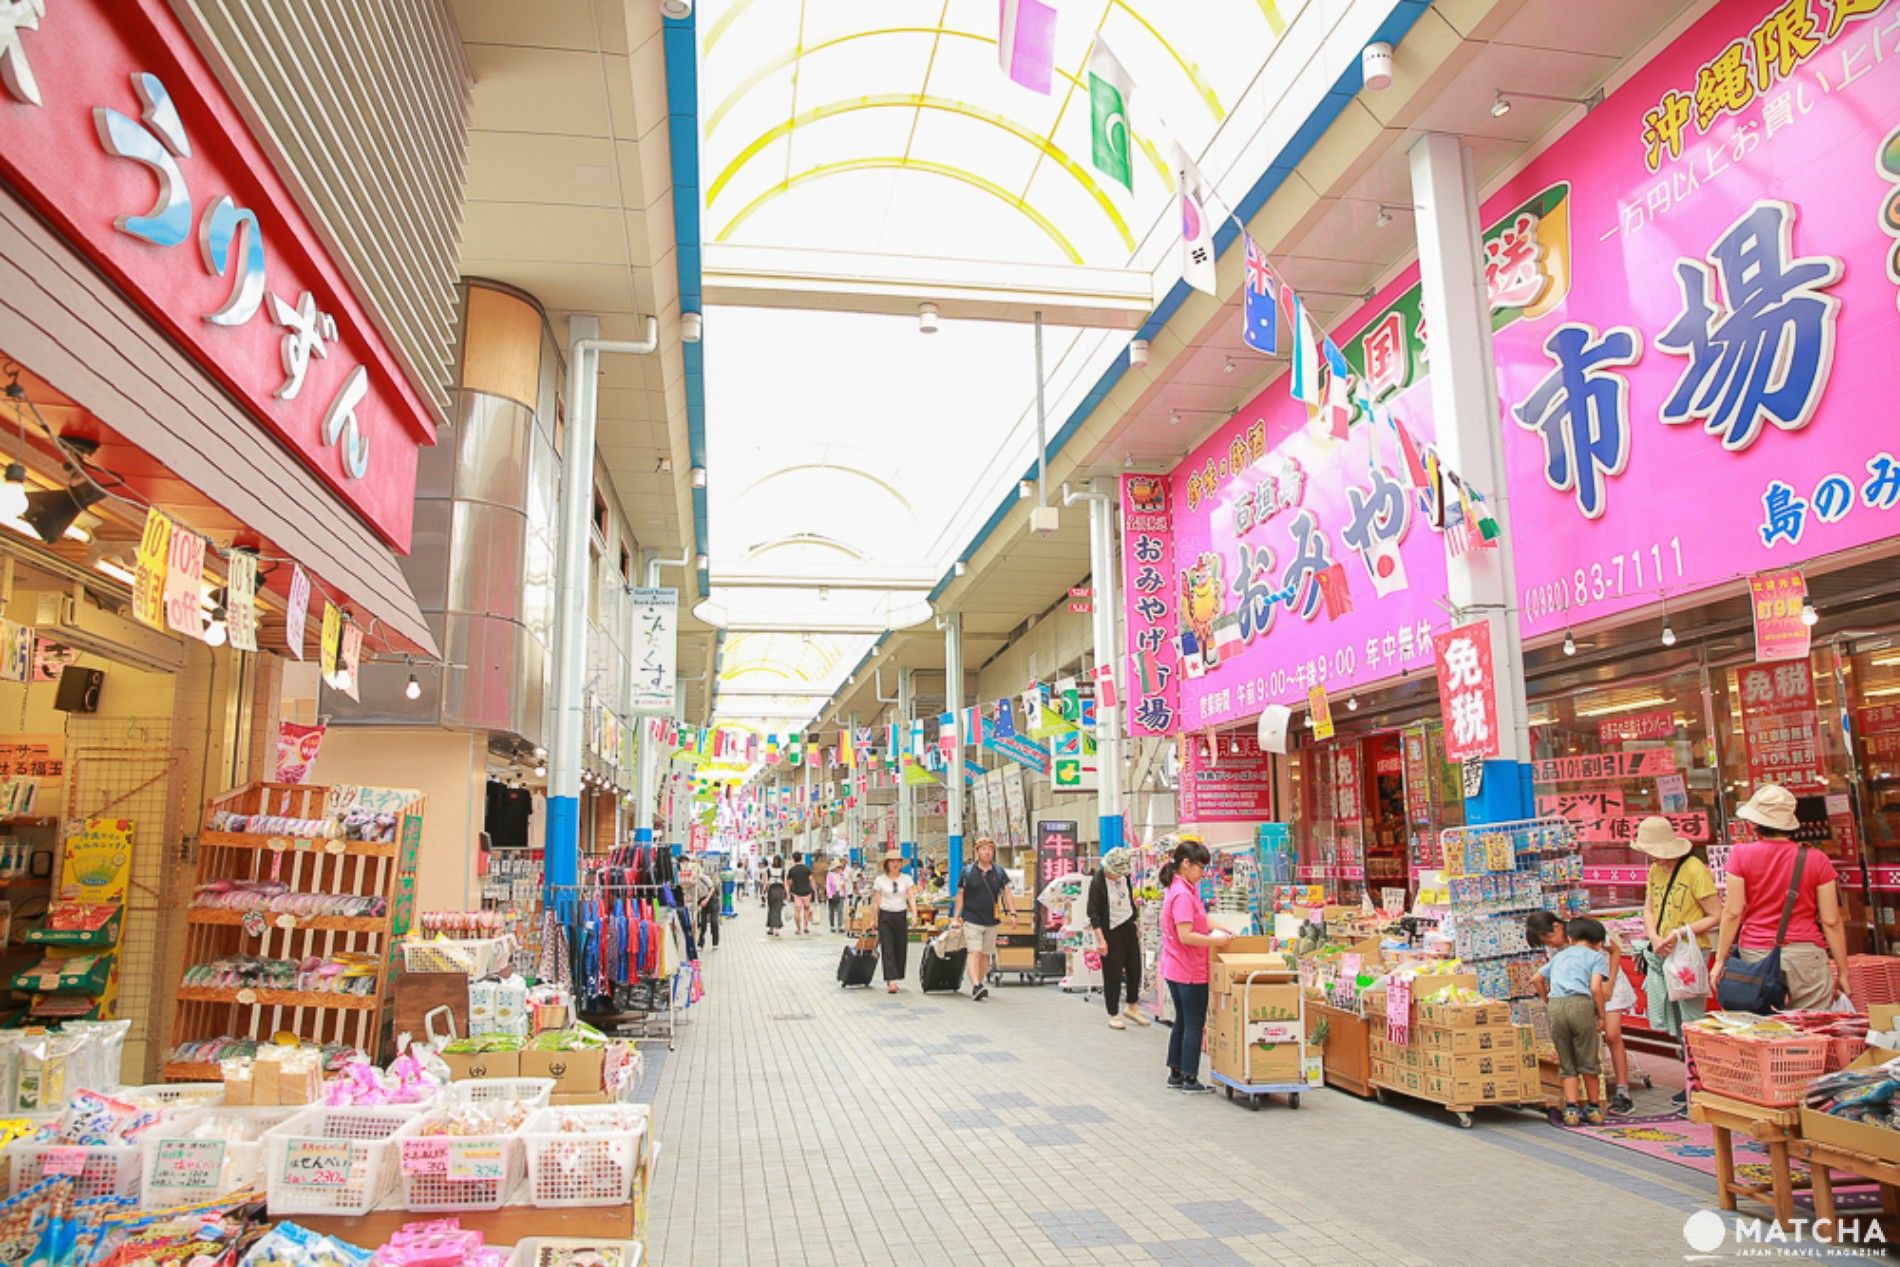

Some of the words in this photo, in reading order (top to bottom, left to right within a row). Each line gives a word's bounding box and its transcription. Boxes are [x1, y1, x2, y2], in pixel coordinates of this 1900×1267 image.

[0, 0, 370, 480] うりずん
[1573, 536, 1683, 606] 83-7111
[1365, 617, 1434, 671] 年中無休
[1444, 636, 1489, 747] 免税
[1744, 662, 1810, 704] 免税
